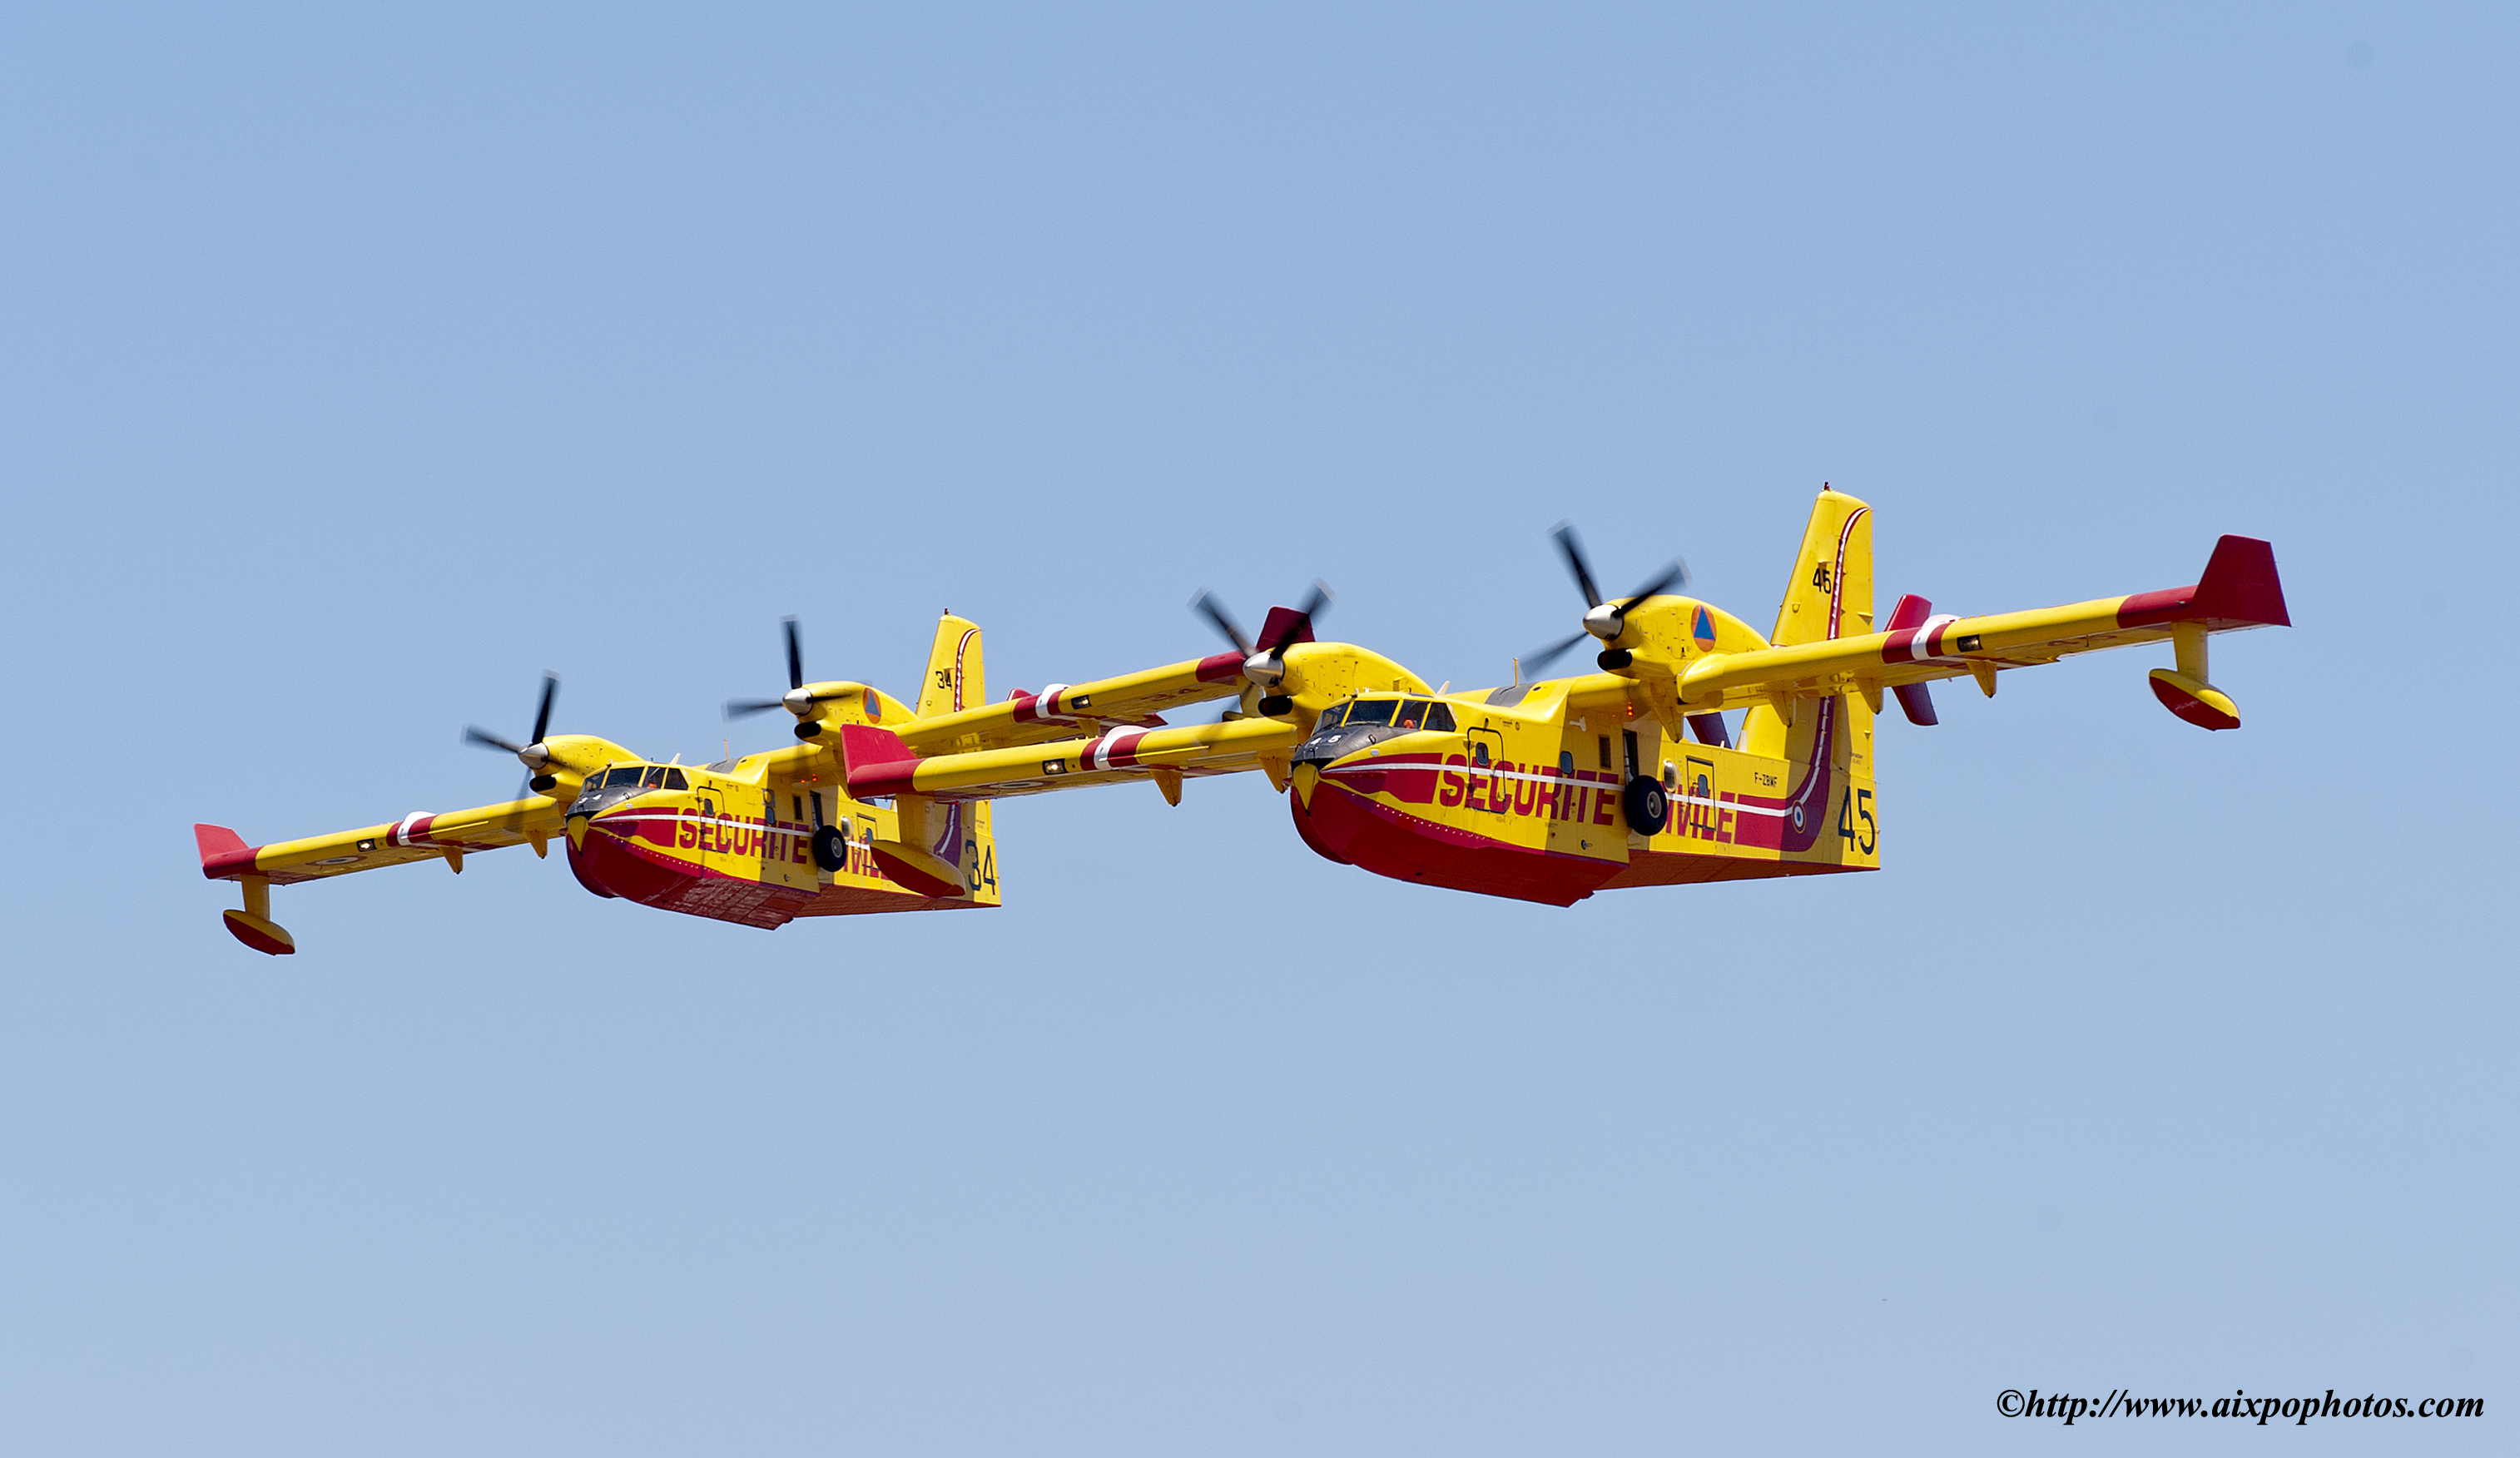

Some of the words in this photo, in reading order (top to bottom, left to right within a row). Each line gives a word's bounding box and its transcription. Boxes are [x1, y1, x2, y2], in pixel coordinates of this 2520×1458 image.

[1813, 568, 1831, 594] 45
[935, 671, 952, 692] 34
[1440, 754, 1619, 826] SECURITE
[679, 808, 809, 864] SECURITE
[1838, 786, 1875, 855] 45
[965, 840, 995, 895] 34
